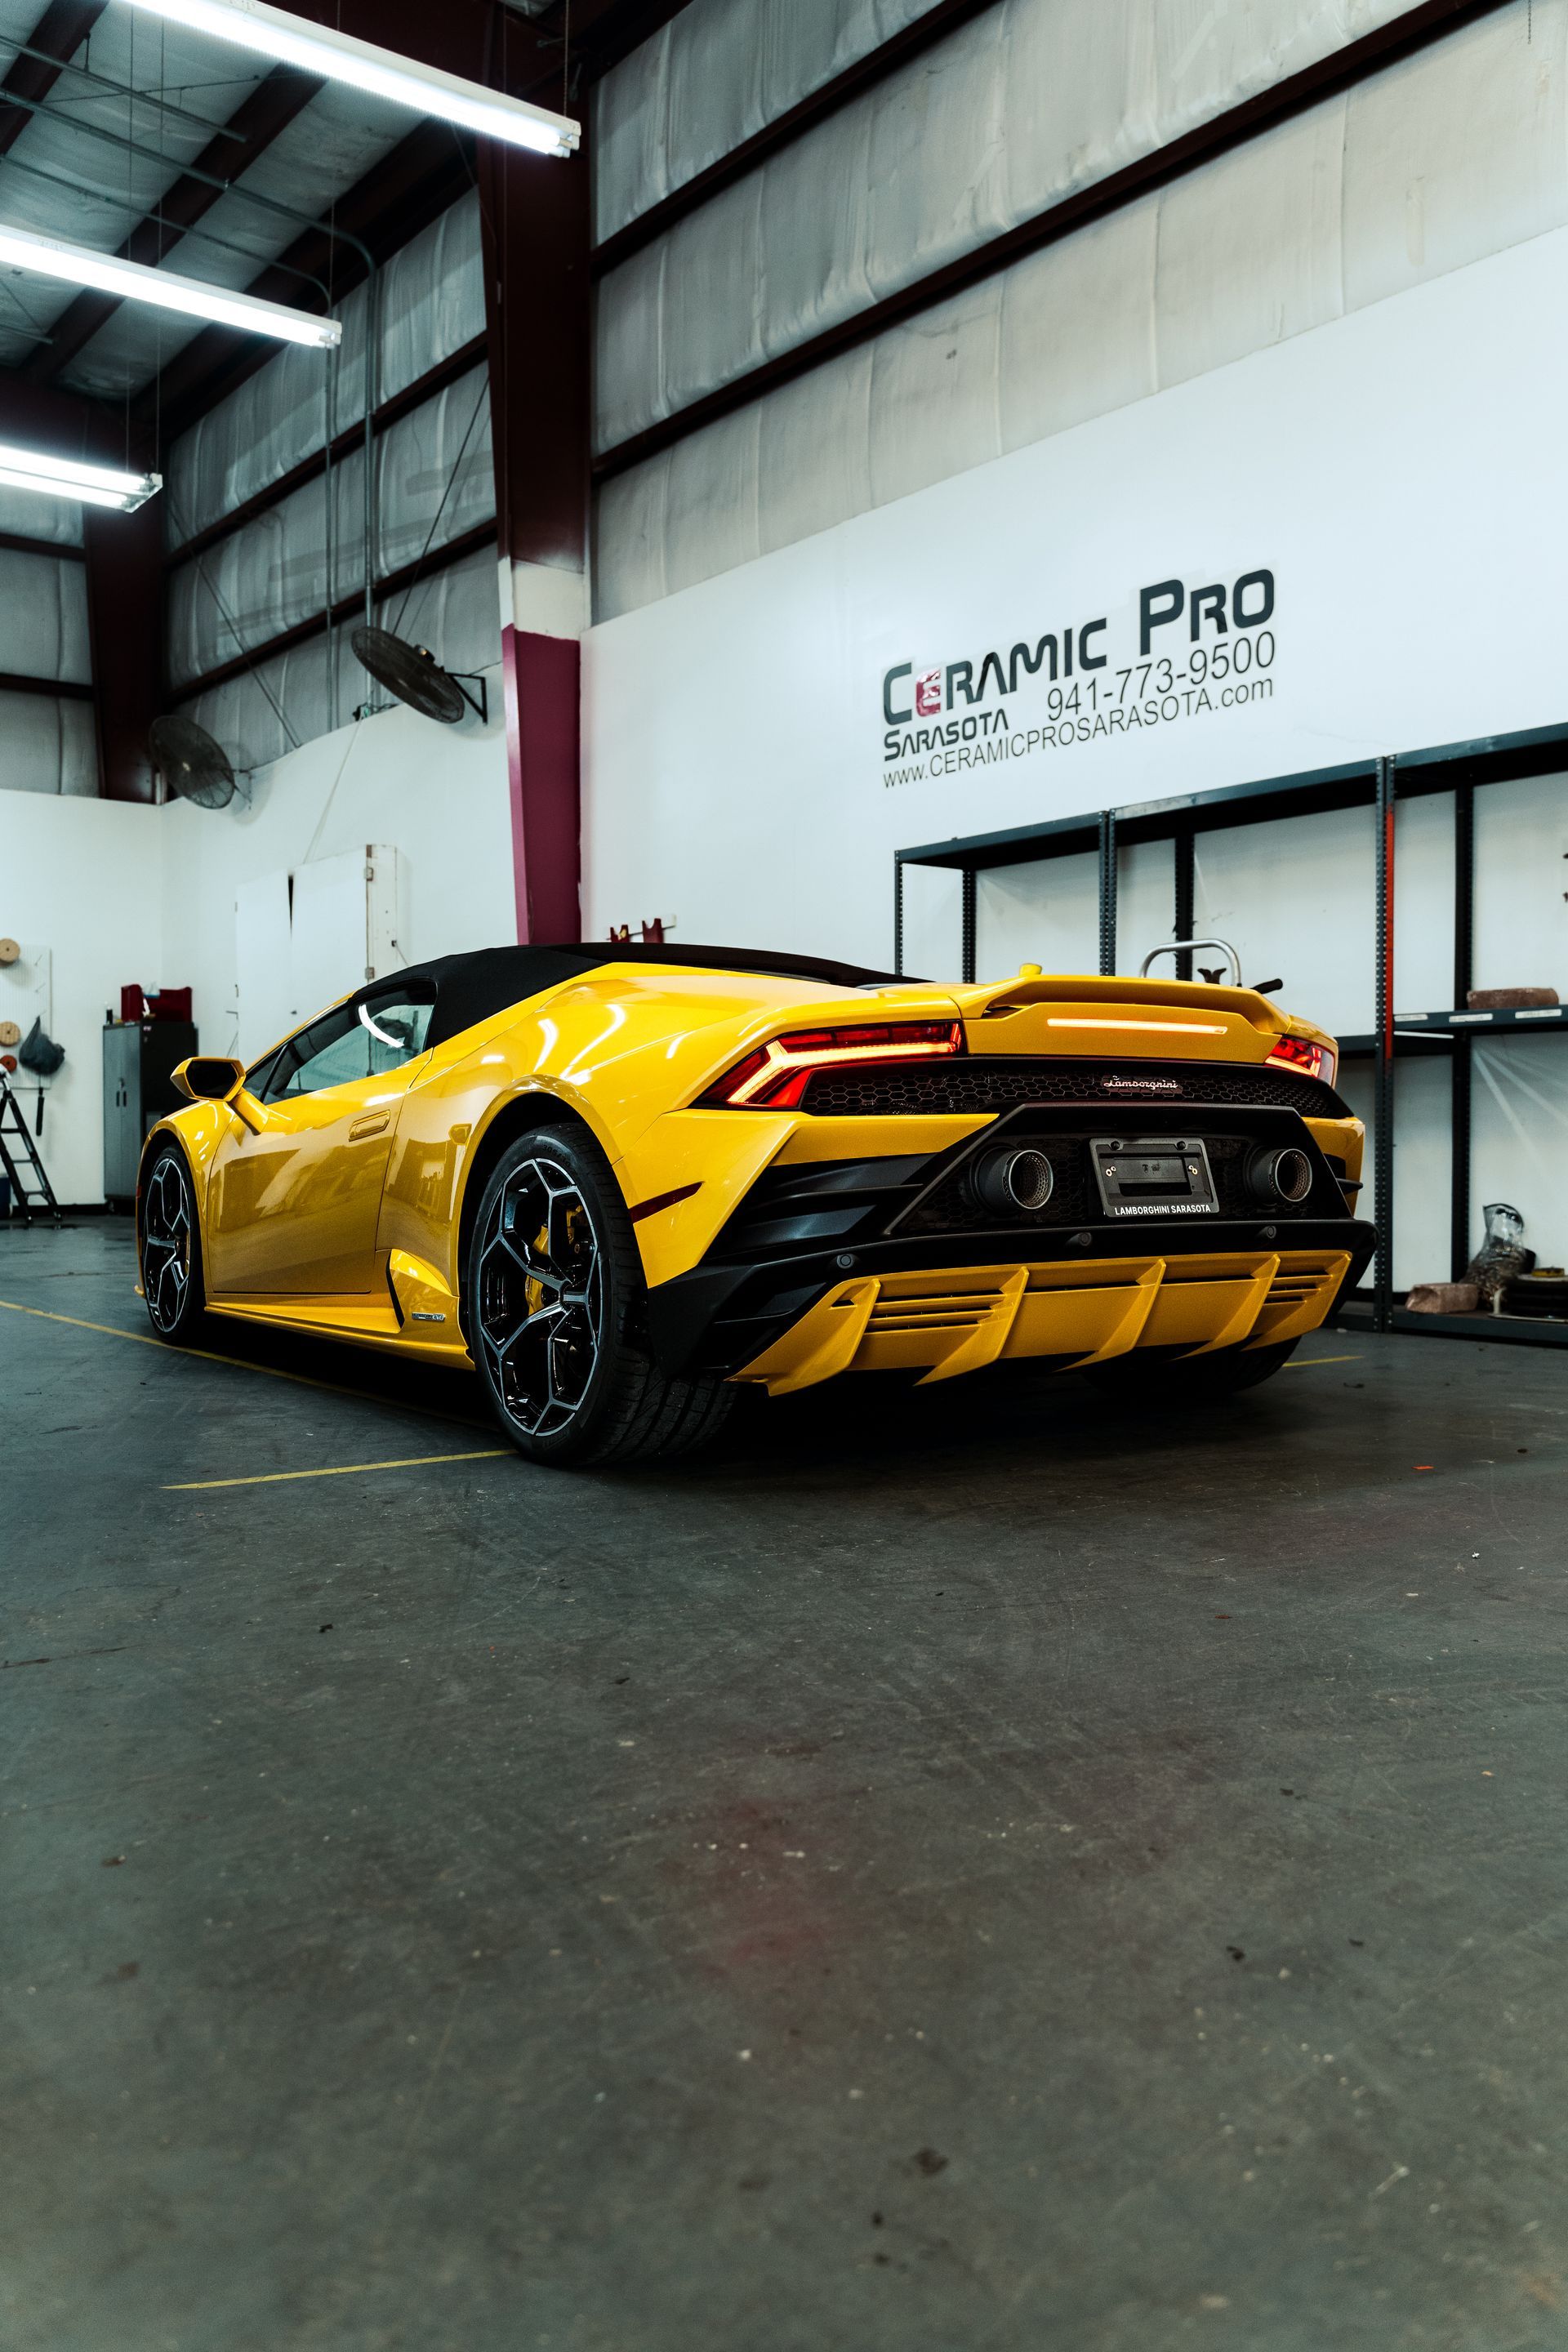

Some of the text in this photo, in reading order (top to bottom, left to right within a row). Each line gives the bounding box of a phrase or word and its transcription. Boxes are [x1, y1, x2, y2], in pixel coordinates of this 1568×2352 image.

[884, 568, 1275, 725] CERAMIC PRO
[1047, 631, 1276, 721] 941-773-9500
[883, 678, 1274, 789] www.CERAMICPROSARASOTA.com
[884, 708, 1009, 761] SARASOTA
[1103, 1075, 1178, 1090] Lamborghini
[1114, 1204, 1211, 1216] LAMBORGHINI SARASOTA
